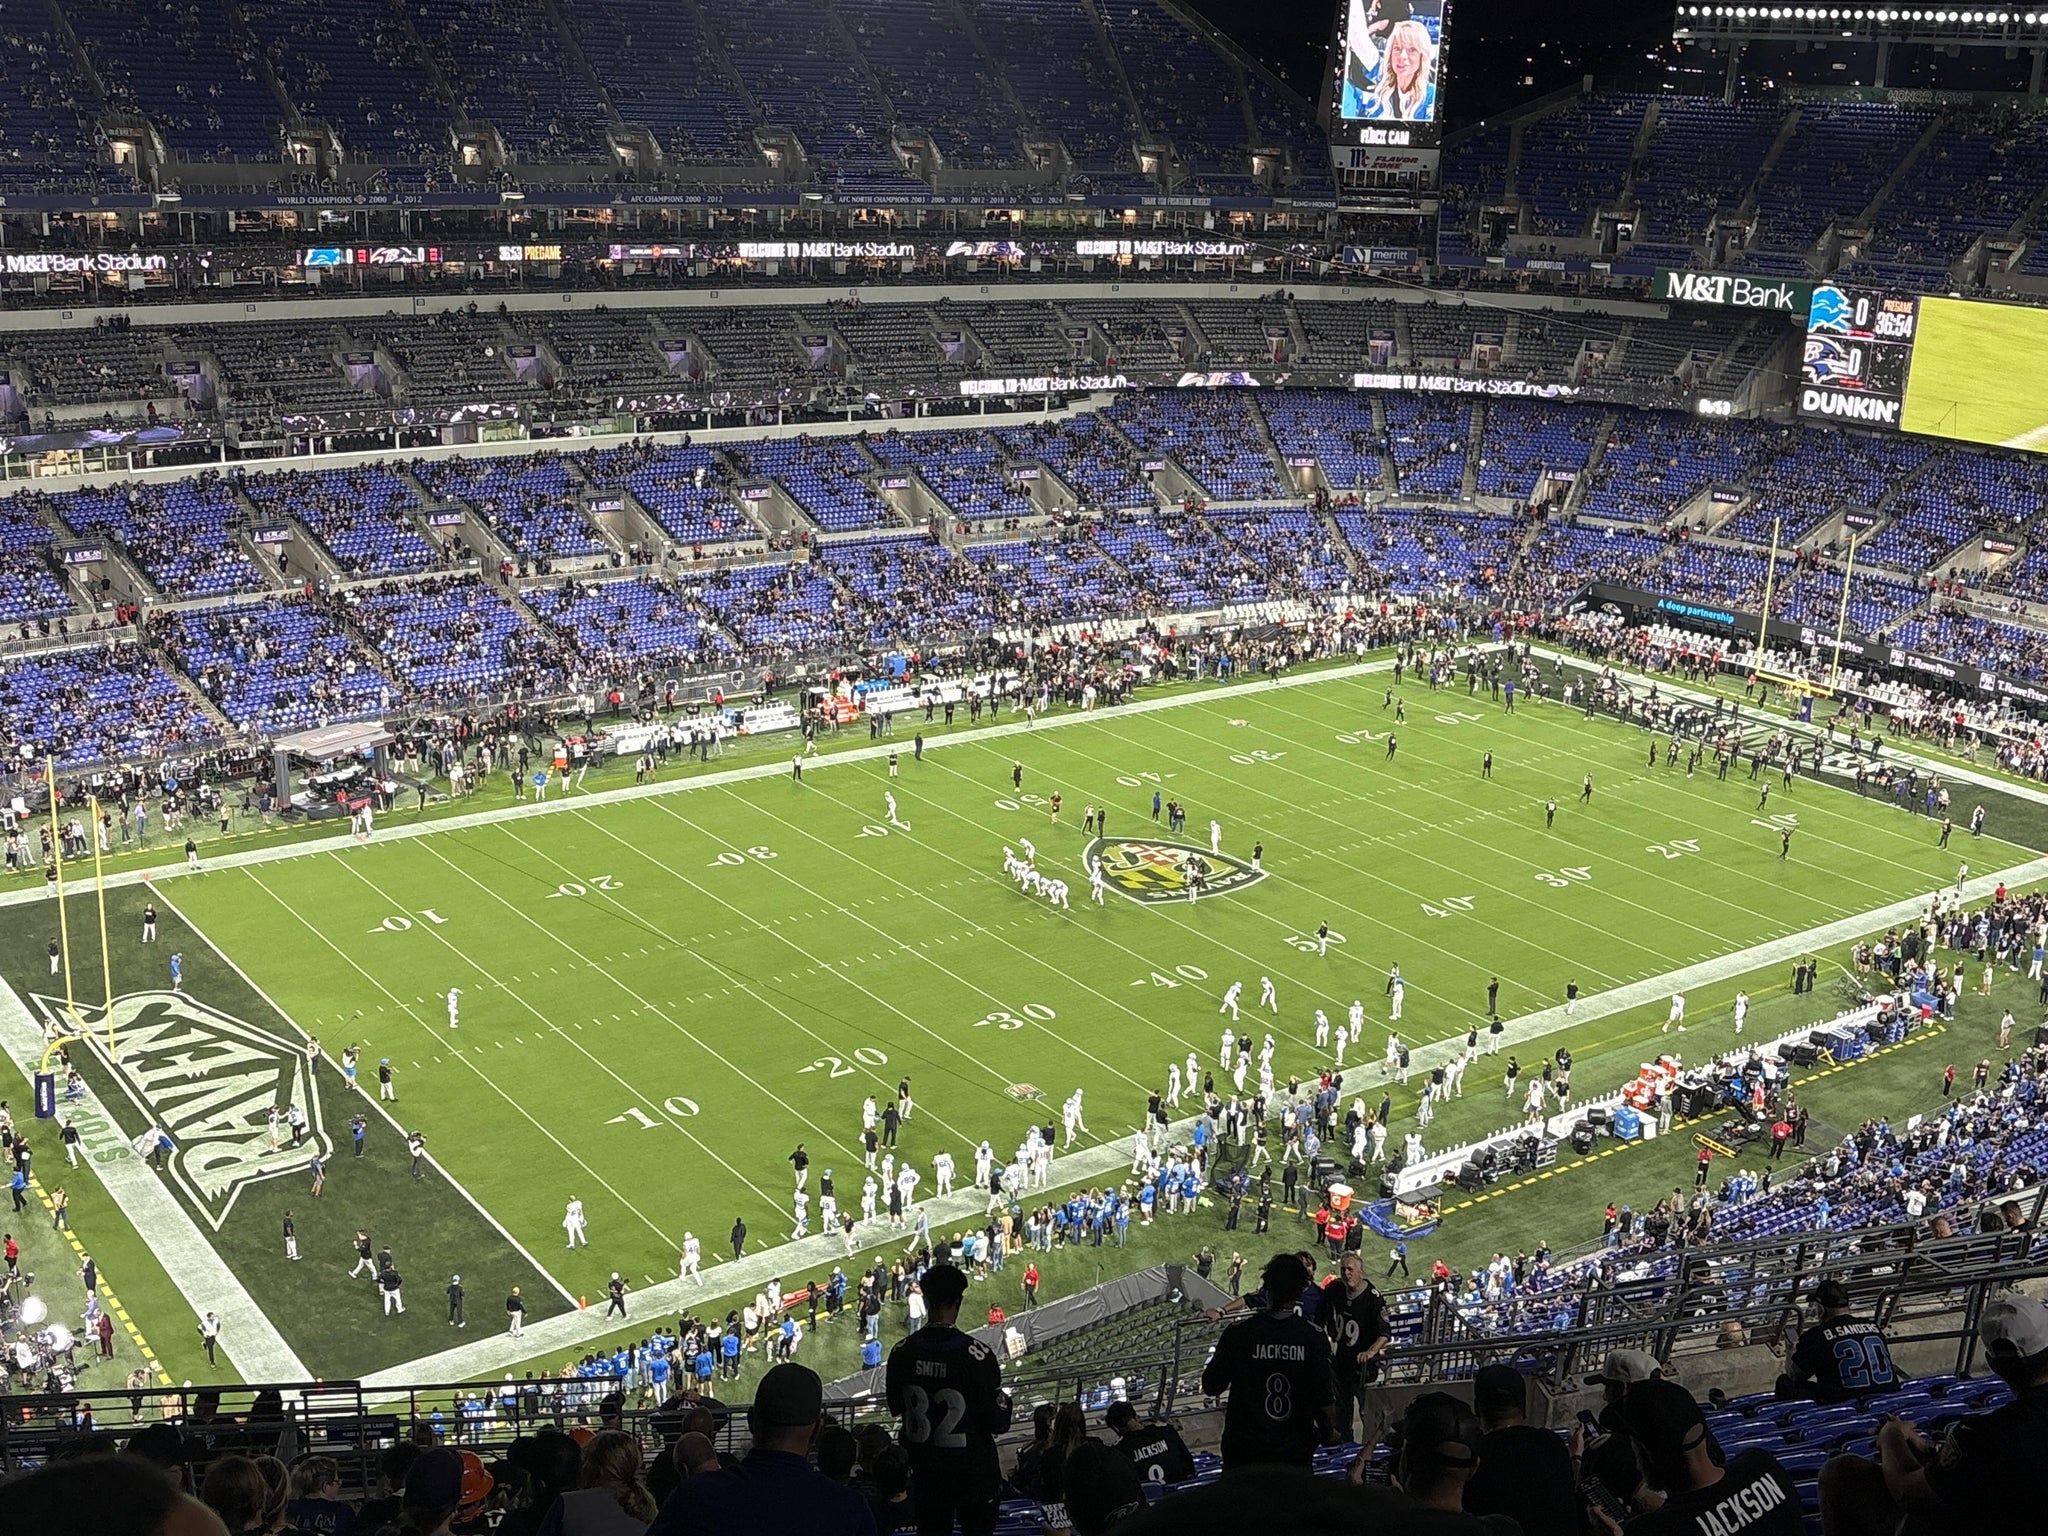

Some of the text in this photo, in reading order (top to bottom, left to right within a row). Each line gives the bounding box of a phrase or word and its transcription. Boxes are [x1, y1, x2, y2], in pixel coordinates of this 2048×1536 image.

[1887, 89, 1974, 106] HONOR ROWS
[1388, 130, 1410, 145] CAM
[1375, 155, 1419, 164] FLAVOR
[307, 196, 352, 204] CHAMPIONS
[368, 196, 387, 204] 2000
[404, 195, 422, 203] 2012
[644, 195, 683, 203] CHAMPIONS
[706, 195, 723, 203] 2012
[524, 245, 562, 260] PREGAME
[738, 242, 914, 257] WELCOME TO M&T Bank Stadium
[1076, 240, 1244, 256] WELCOME TO M&T Bank Stadium
[1372, 249, 1408, 260] merritt
[7, 253, 166, 272] M&T Bank Stadium
[1526, 260, 1566, 271] #RAVENSFLOCK
[1667, 271, 1795, 310] M&T Bank
[1855, 297, 1869, 326] 0
[1883, 299, 1913, 314] PREGAME
[1875, 311, 1913, 338] 36:54
[1848, 347, 1862, 376] 0
[960, 379, 1005, 394] WELCOME
[1019, 377, 1050, 393] M&T
[1050, 376, 1080, 391] Bank
[1080, 375, 1127, 390] Stadium
[1354, 373, 1542, 396] WELCOME TO M&T Bank Stadium
[1802, 389, 1900, 424] DUNKIN'
[1992, 541, 2015, 551] CAESARS
[1657, 599, 1735, 624] A deep partnership
[1434, 710, 1482, 725] 10
[1335, 729, 1385, 744] 20
[1229, 749, 1281, 765] 30
[1115, 771, 1165, 788] 40
[1749, 813, 1798, 833] 10
[717, 845, 778, 866] 30
[1645, 839, 1696, 860] 20
[557, 874, 624, 897] 20
[1147, 870, 1250, 899] RAVNS
[1534, 867, 1588, 889] 30
[1420, 896, 1472, 919] 40
[382, 907, 449, 931] 10
[1282, 928, 1348, 954] 50
[1145, 963, 1209, 990] 40
[984, 1002, 1057, 1031] 30
[814, 1046, 889, 1079] 20
[40, 993, 324, 1204] RAVENS
[621, 1096, 701, 1131] 10
[71, 1109, 130, 1163] STOP
[1335, 1313, 1360, 1348] 99
[1823, 1321, 1880, 1341] B. SANDERS
[1252, 1343, 1305, 1361] JACKSON
[1832, 1335, 1895, 1388] 20
[915, 1358, 947, 1379] SMITH
[1265, 1372, 1291, 1421] 8
[902, 1384, 968, 1449] 82
[1133, 1439, 1169, 1462] JACKSON
[1042, 1502, 1065, 1513] KEEP
[1695, 1472, 1787, 1536] JACKSON
[315, 1513, 336, 1527] Girl
[1047, 1509, 1068, 1522] FAN
